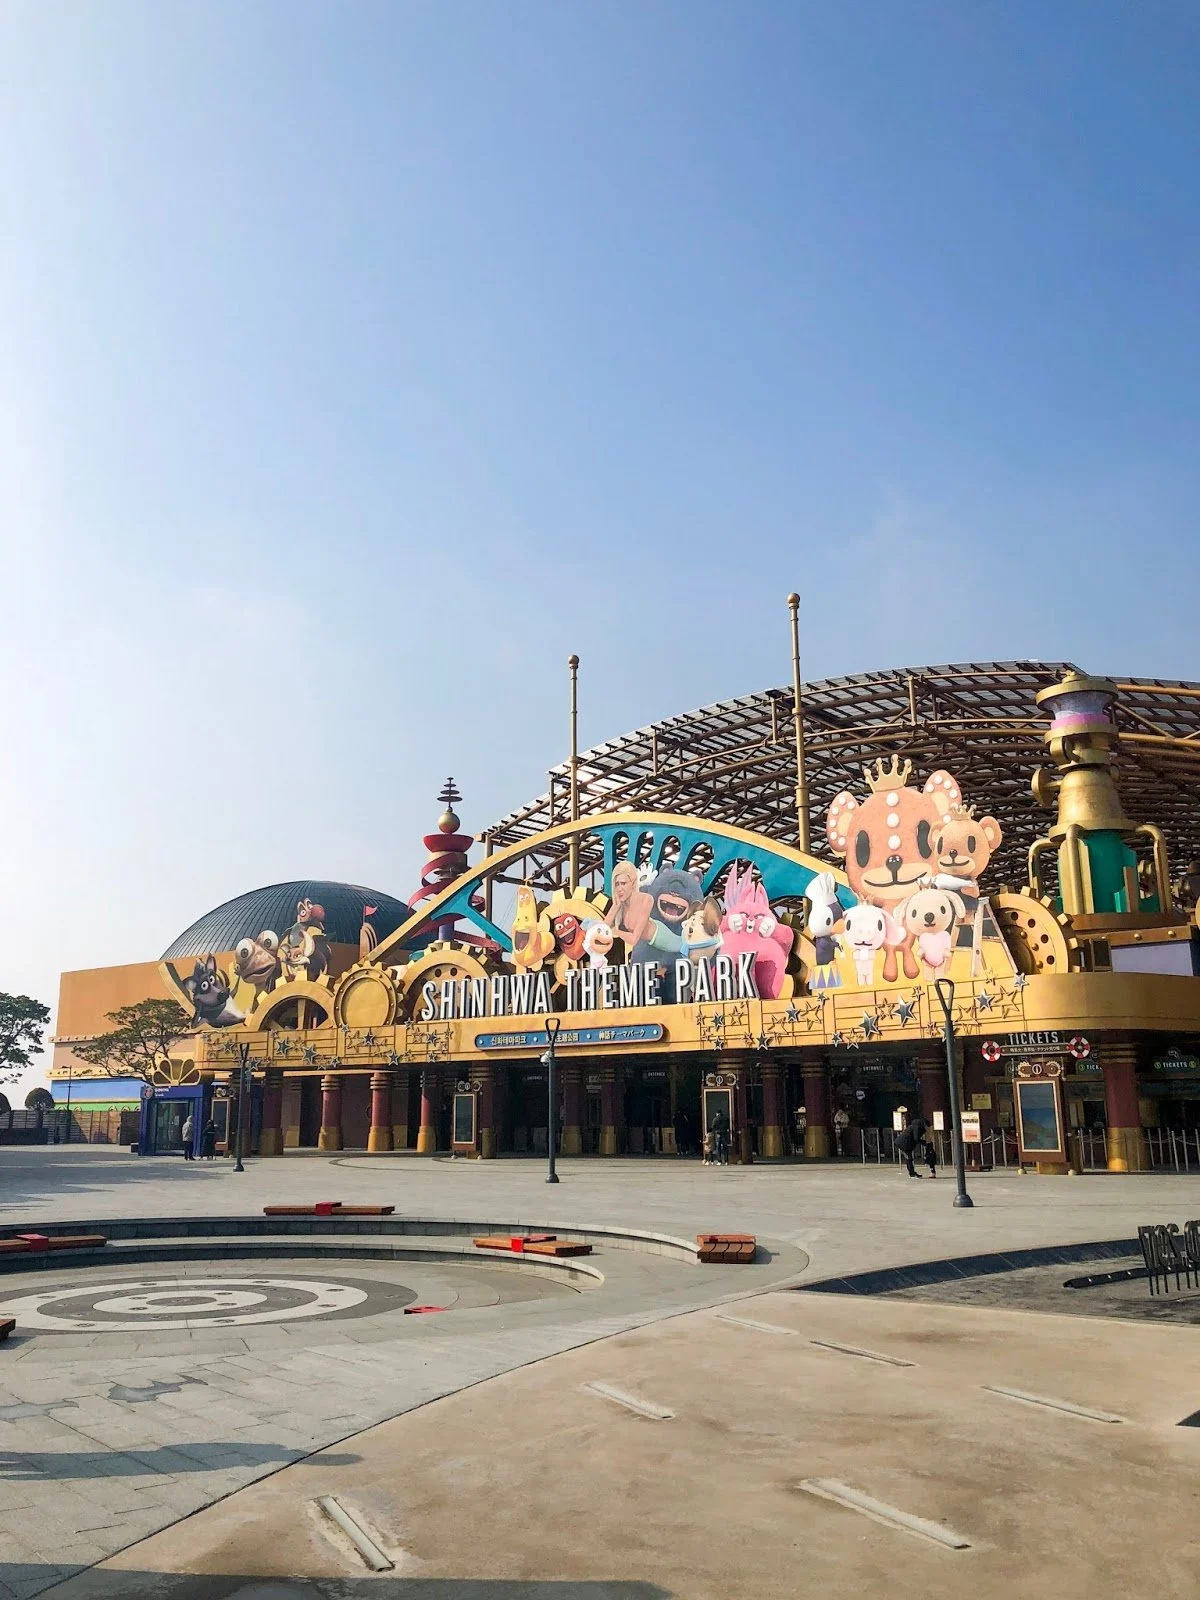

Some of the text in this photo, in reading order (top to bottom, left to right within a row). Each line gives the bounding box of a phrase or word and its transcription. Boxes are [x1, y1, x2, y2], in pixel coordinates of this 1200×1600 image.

[421, 951, 760, 1020] SHINHWA THEME PARK
[1007, 1031, 1059, 1045] TICKETS
